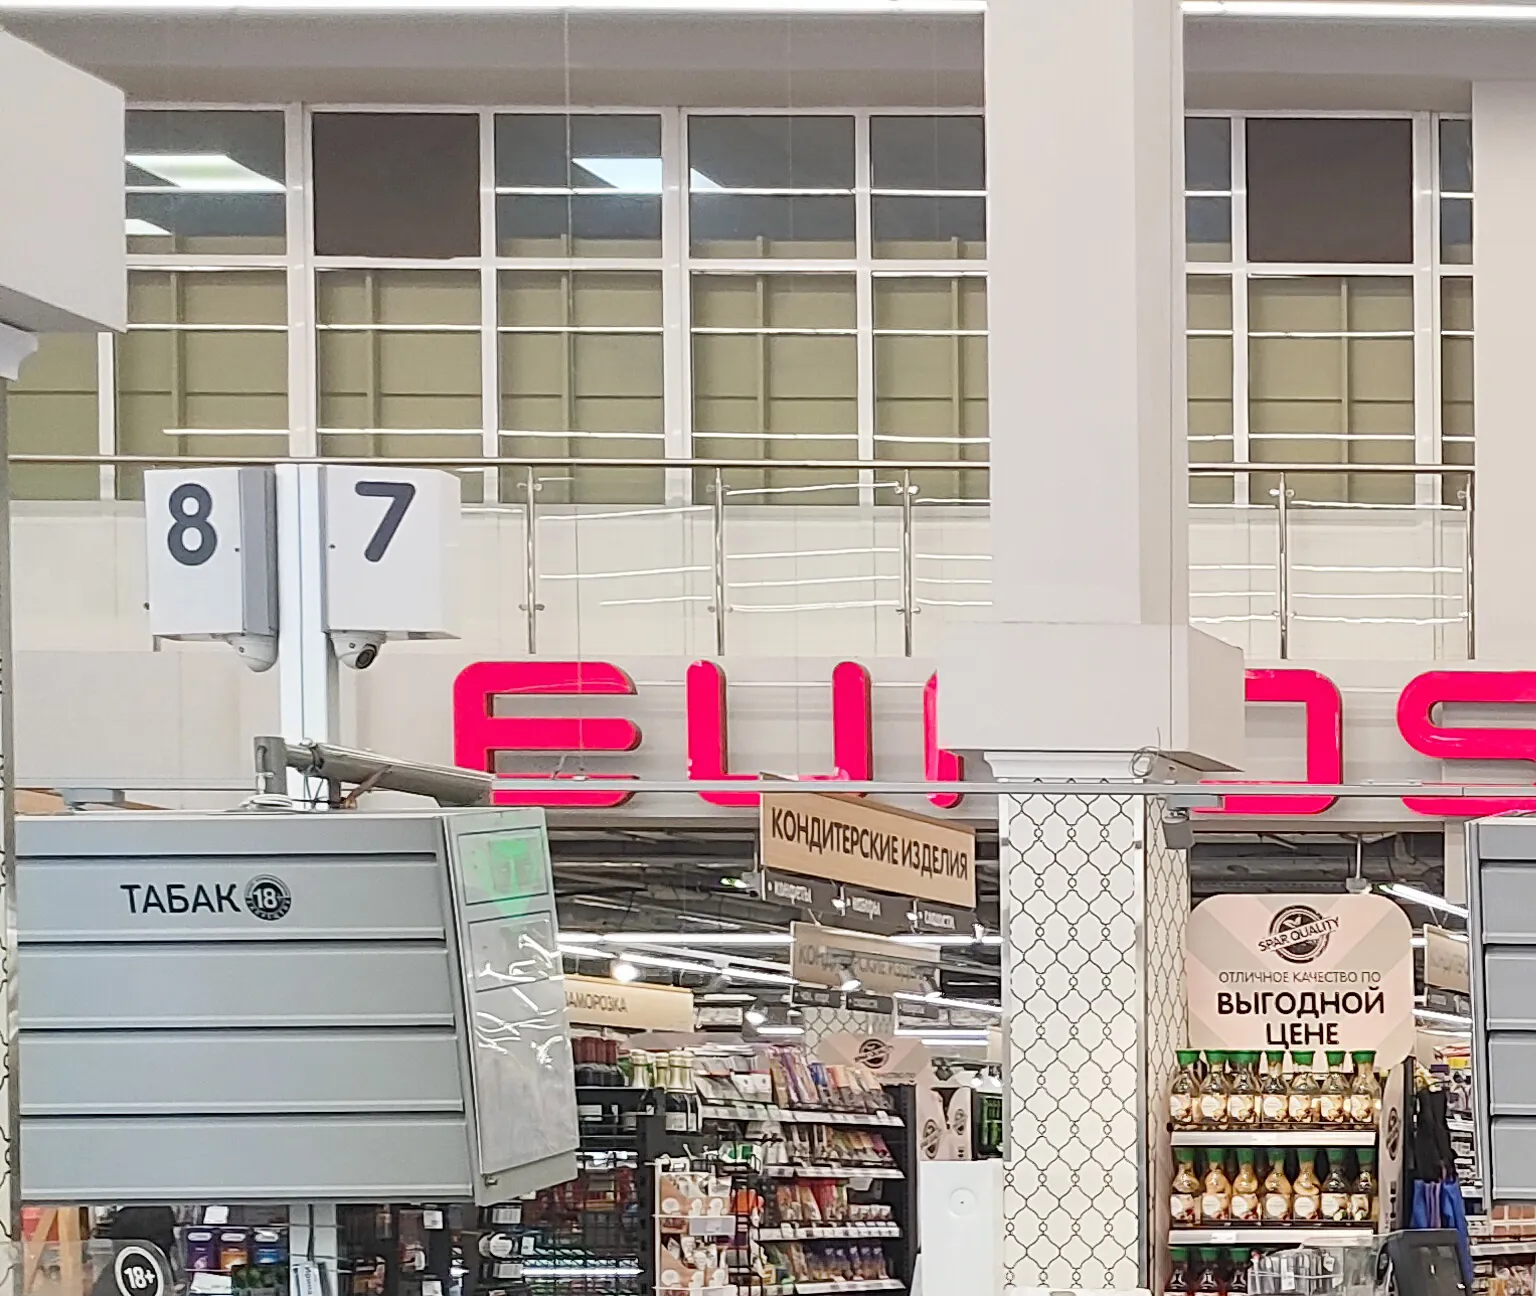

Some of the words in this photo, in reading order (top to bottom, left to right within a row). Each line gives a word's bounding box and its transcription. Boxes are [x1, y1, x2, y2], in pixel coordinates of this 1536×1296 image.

[167, 482, 218, 566] 8
[354, 481, 416, 562] 7
[771, 806, 898, 865] КОНДИТЕРСКИЕ
[901, 845, 968, 880] ИЗДЕЛИЯ
[120, 883, 242, 914] ТАБАК
[1258, 934, 1290, 952] SPAR
[1290, 916, 1339, 941] QUALITY
[1218, 971, 1289, 984] ОТЛИЧНОЕ
[1293, 971, 1358, 984] КАЧЕСТВО
[1362, 971, 1381, 984] ПО
[1217, 986, 1385, 1018] ВЫГОДНОЙ
[1266, 1023, 1340, 1049] ЦЕНЕ
[124, 1266, 155, 1289] 18+
